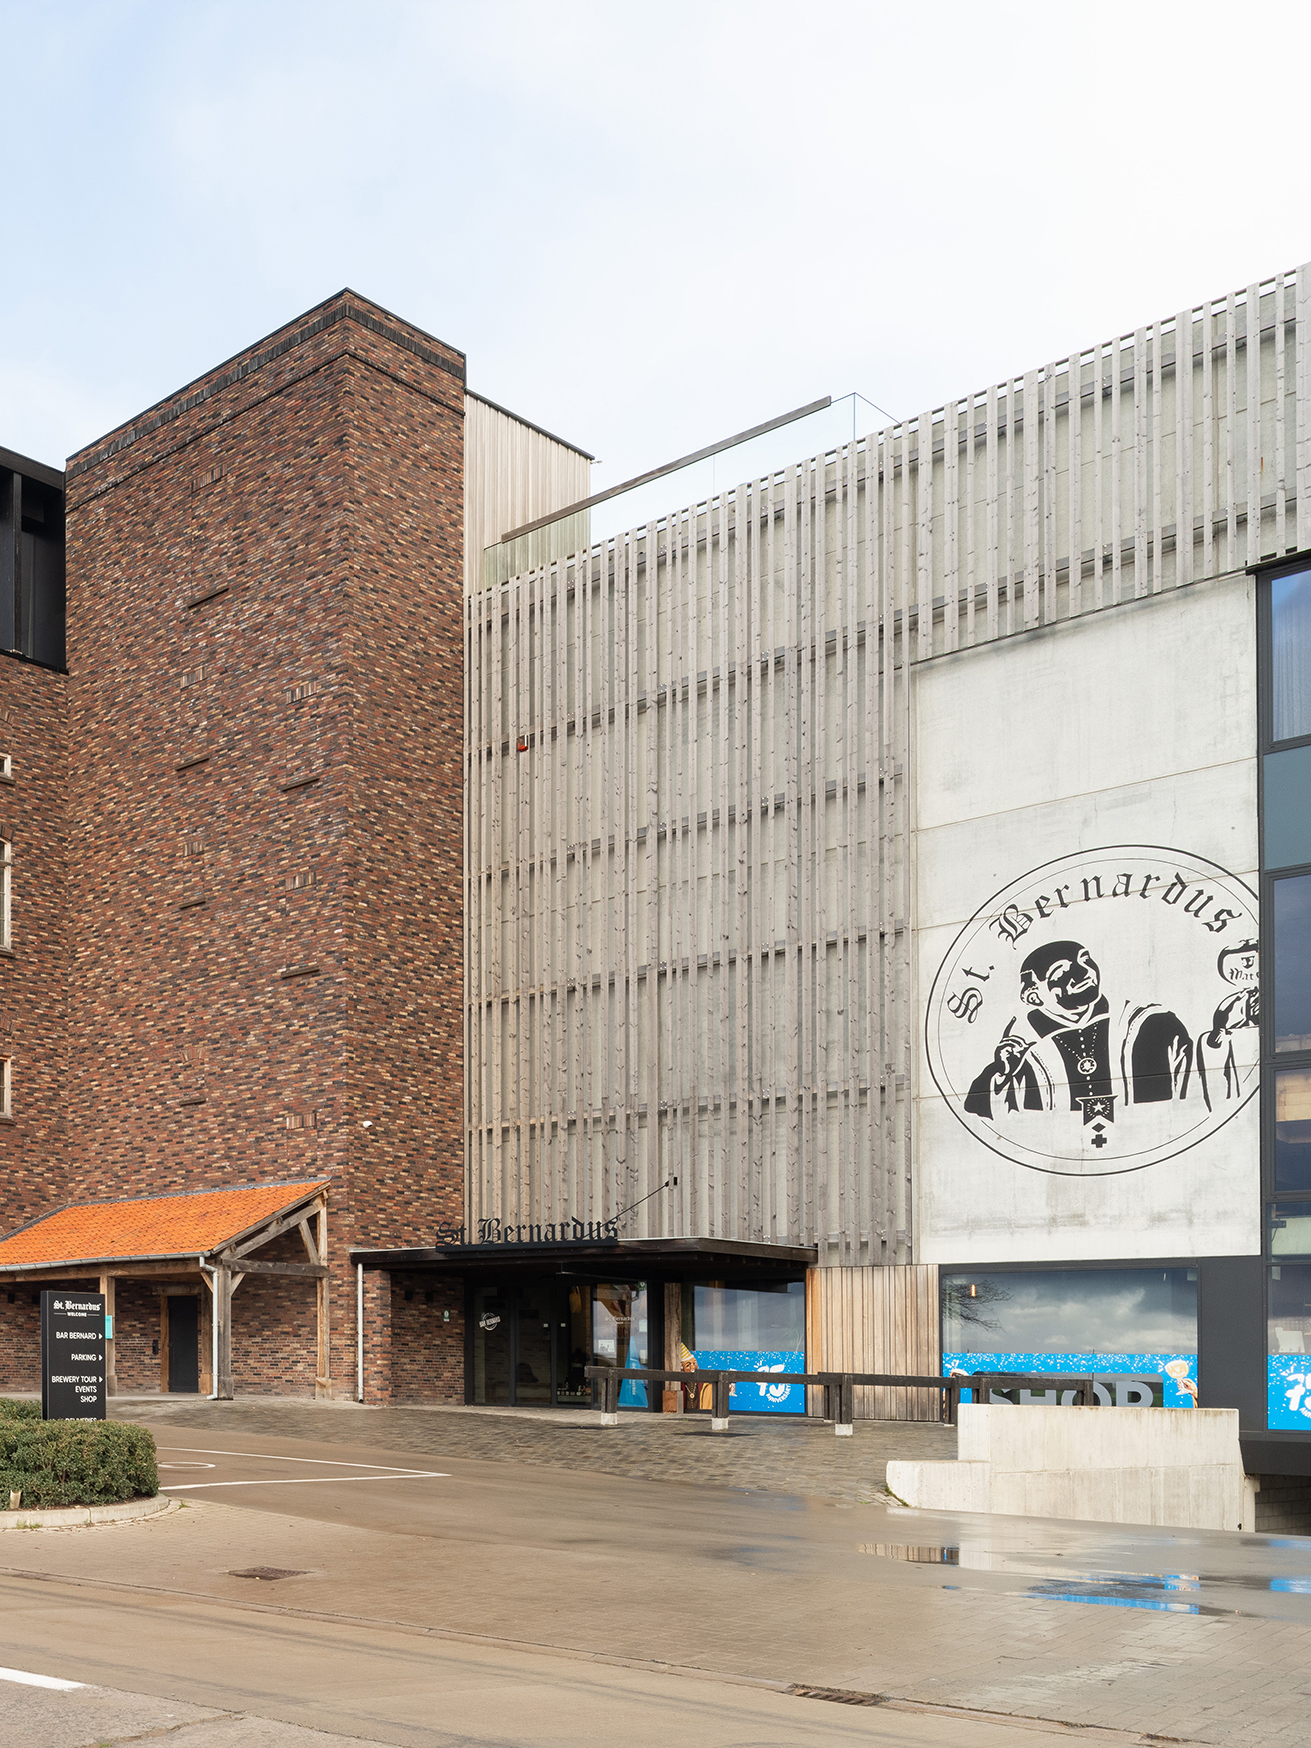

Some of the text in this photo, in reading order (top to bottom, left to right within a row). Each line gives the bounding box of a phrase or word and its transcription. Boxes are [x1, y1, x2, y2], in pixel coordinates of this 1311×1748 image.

[947, 872, 1243, 1023] St. Bernardus
[436, 1215, 619, 1247] St. Bernardus
[53, 1300, 102, 1311] St. Bernardus
[55, 1331, 97, 1340] BAR BERNARD
[71, 1353, 97, 1361] PARKING
[51, 1375, 97, 1383] BREWERY TOUR
[75, 1385, 97, 1393] EVENTS
[80, 1395, 97, 1403] SHOP
